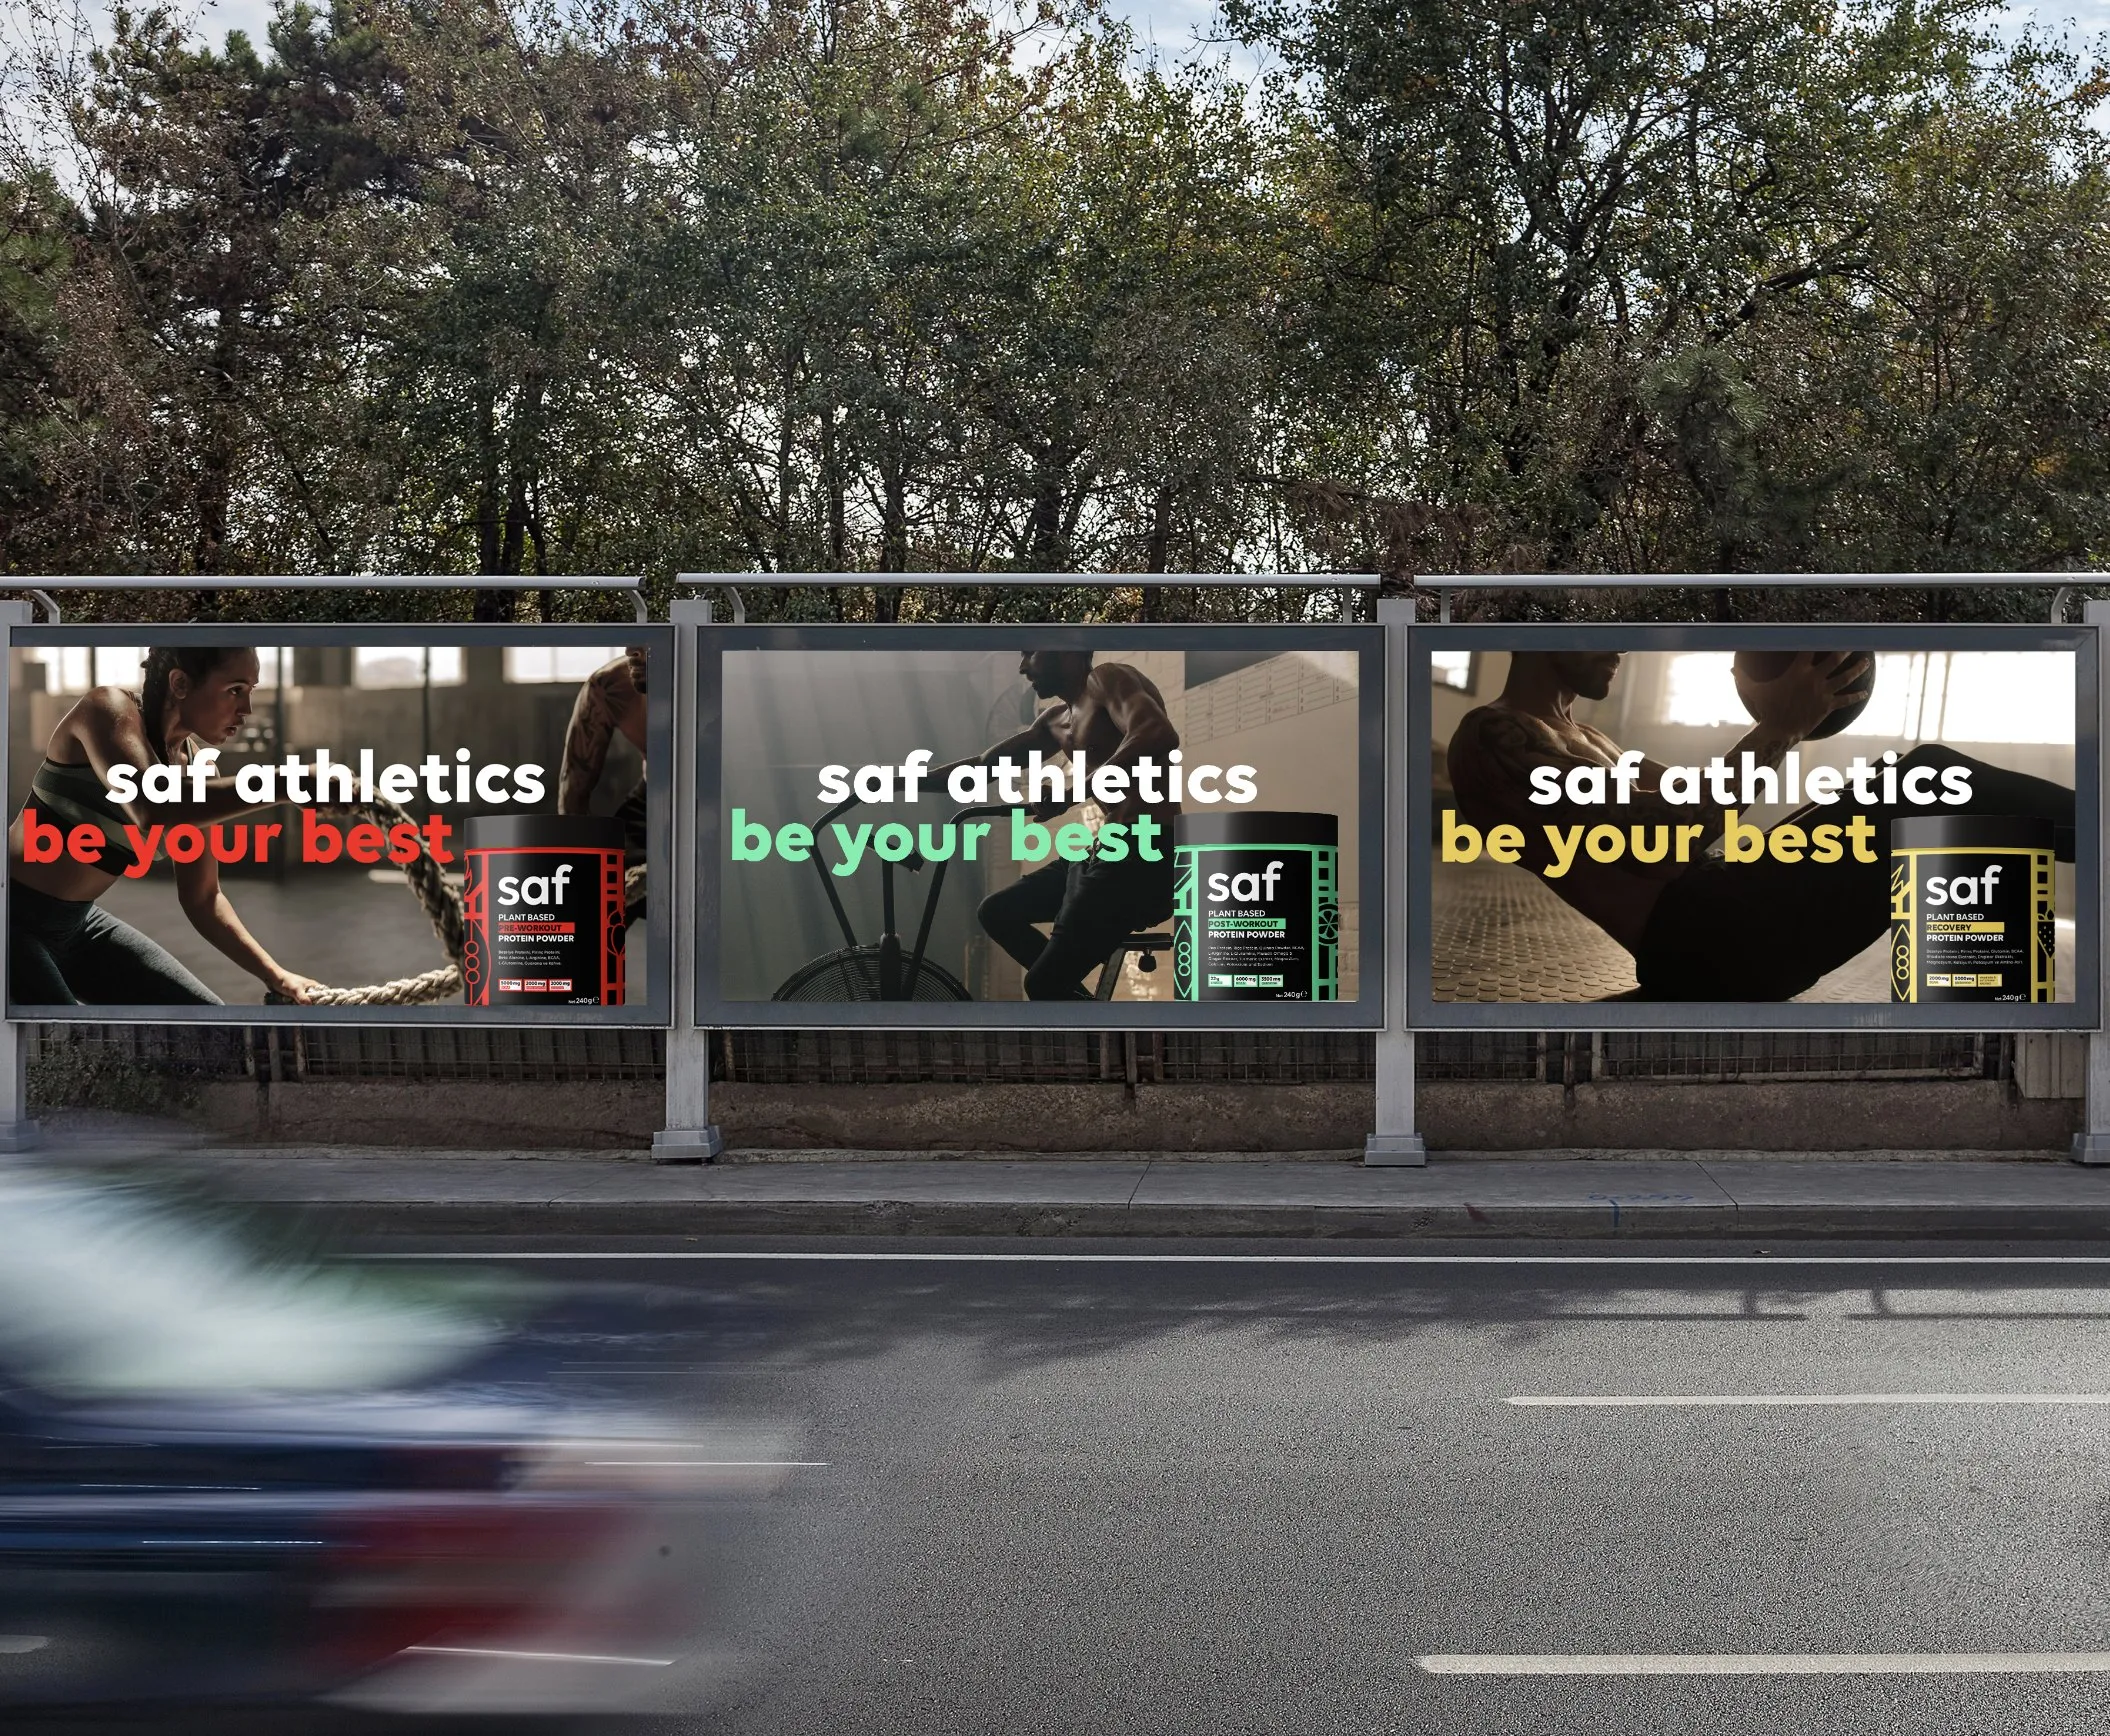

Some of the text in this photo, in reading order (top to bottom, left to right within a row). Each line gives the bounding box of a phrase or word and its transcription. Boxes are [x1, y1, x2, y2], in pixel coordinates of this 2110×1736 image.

[105, 747, 545, 804] saf athletics
[817, 749, 1258, 804] saf athletics
[1528, 750, 1973, 805] saf athletics
[23, 809, 454, 879] be your best
[731, 808, 1164, 877] be your best
[1442, 810, 1877, 878] be your best
[497, 864, 573, 906] saf
[1207, 861, 1284, 902] saf
[1925, 864, 2003, 906] saf
[498, 913, 555, 921] PLANT BASED
[499, 924, 562, 932] PRE-WORKOUT
[1208, 910, 1266, 918] PLANT BASED
[1926, 913, 1985, 921] PLANT BASED
[498, 934, 575, 942] PROTEIN POWDER
[1208, 931, 1285, 939] PROTEIN POWDER
[1926, 934, 2004, 942] PROTEIN POWDER
